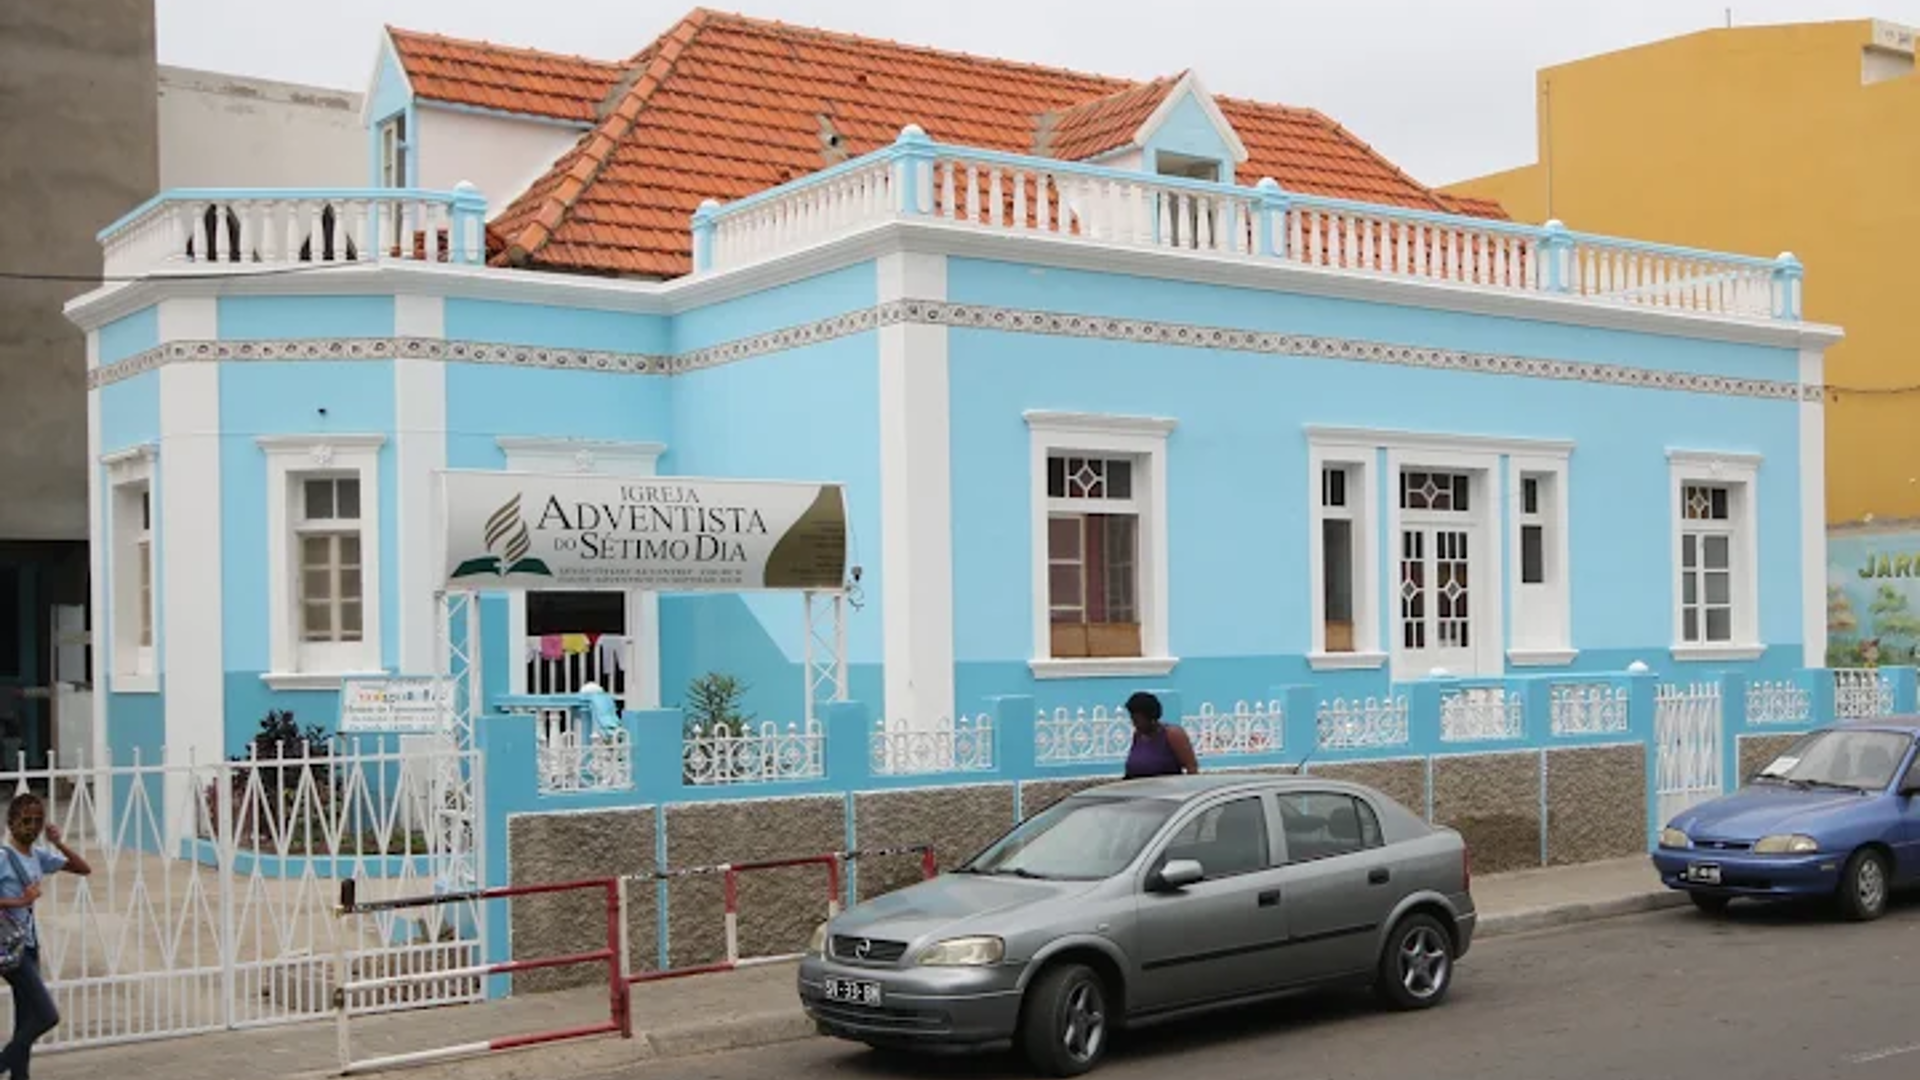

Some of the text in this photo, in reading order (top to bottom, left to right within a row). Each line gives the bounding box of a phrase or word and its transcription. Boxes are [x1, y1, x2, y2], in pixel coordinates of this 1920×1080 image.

[620, 486, 700, 503] IGREJA
[536, 494, 768, 534] ADVENTISTA
[554, 531, 747, 561] DO SÉTIMO DIA
